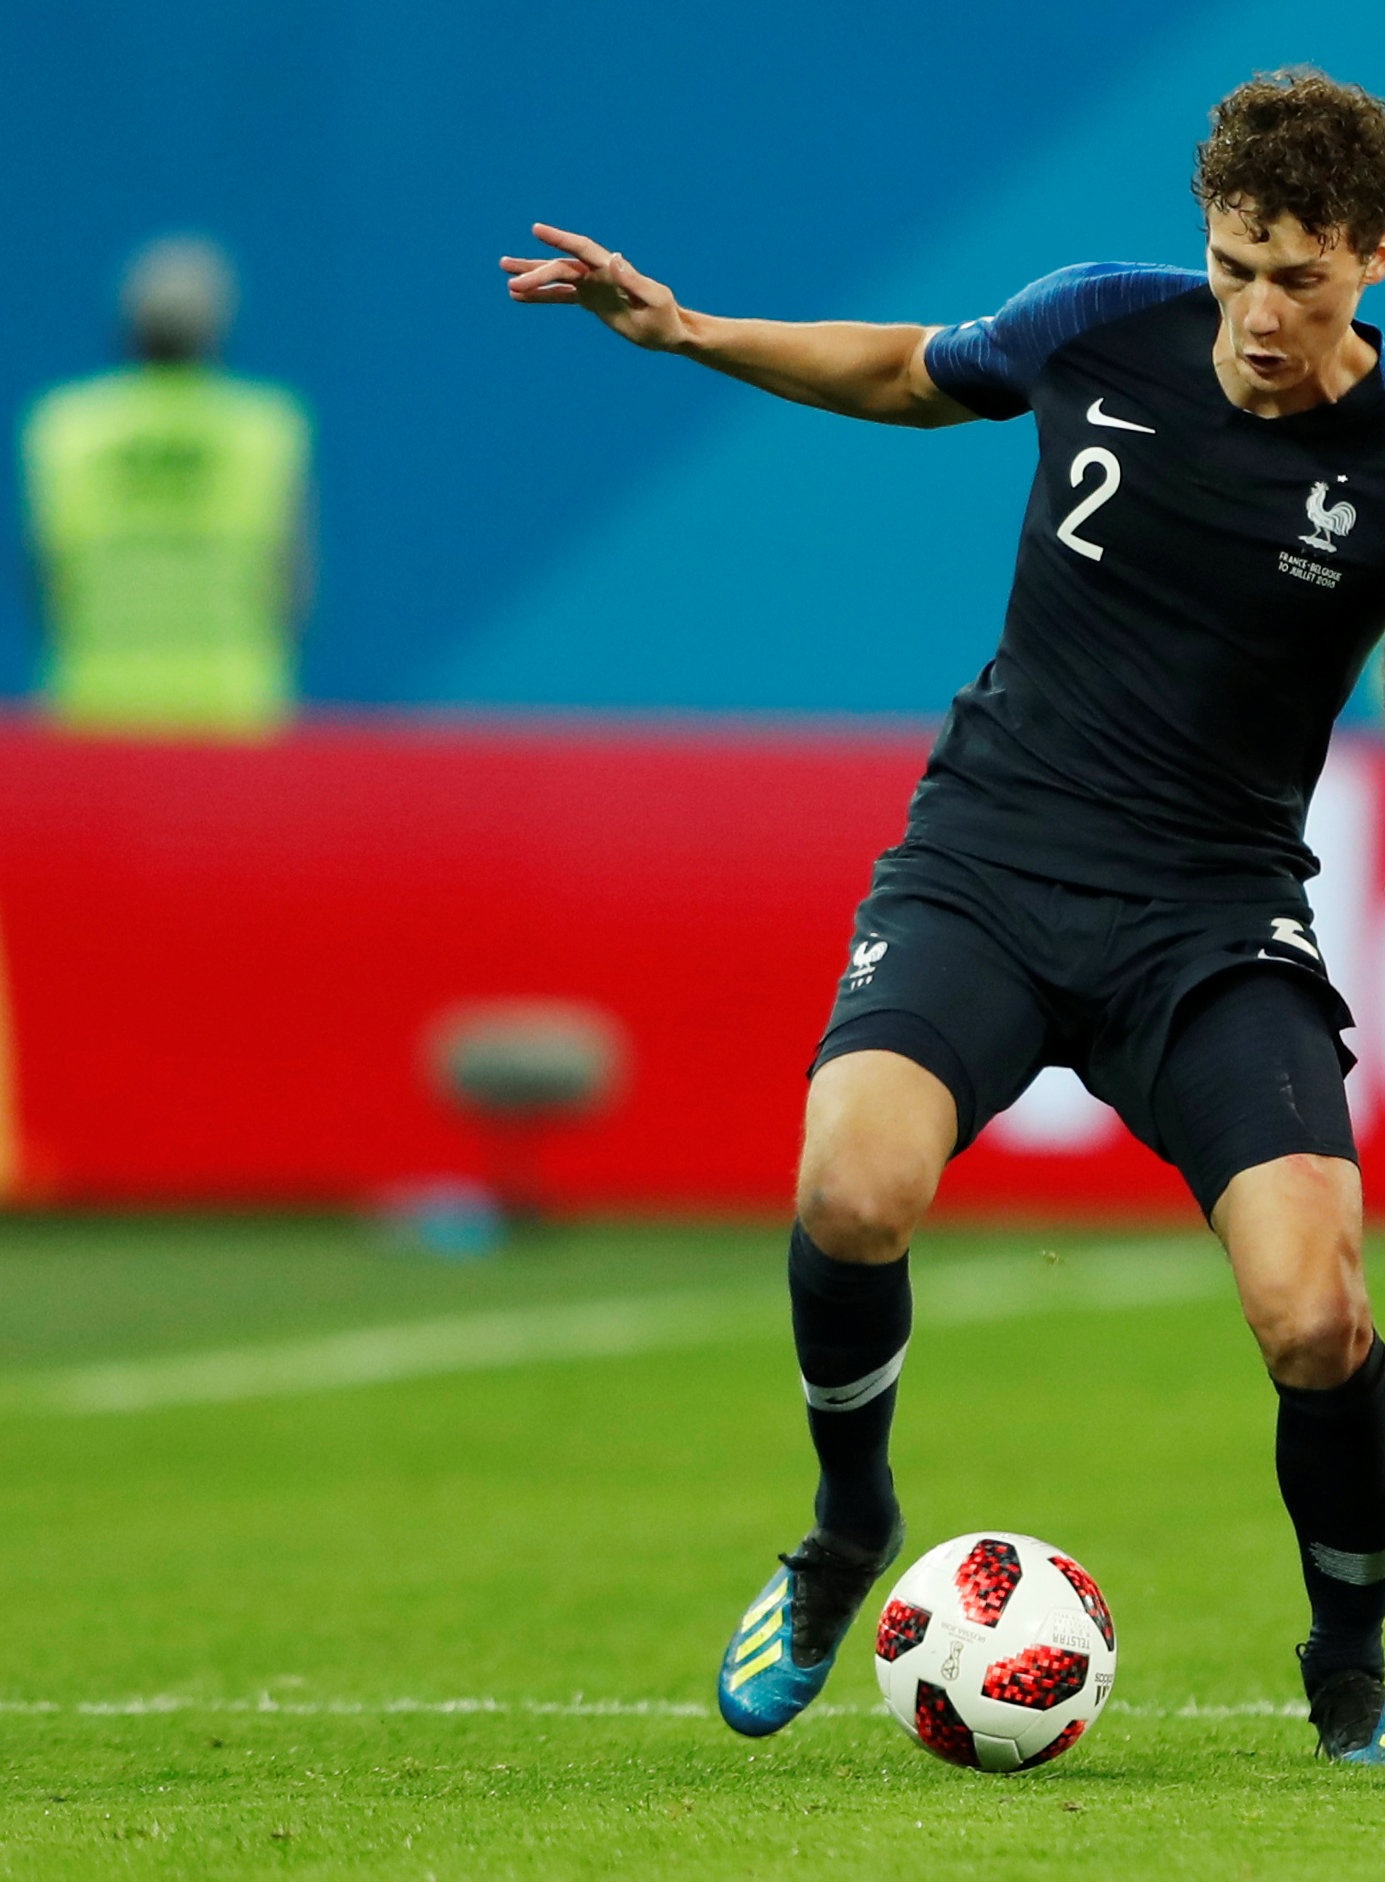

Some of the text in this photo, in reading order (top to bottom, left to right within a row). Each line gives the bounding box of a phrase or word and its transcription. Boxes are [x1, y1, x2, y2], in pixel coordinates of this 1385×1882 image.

[1056, 446, 1122, 562] 2
[1278, 561, 1289, 572] 10
[1270, 917, 1320, 961] 2
